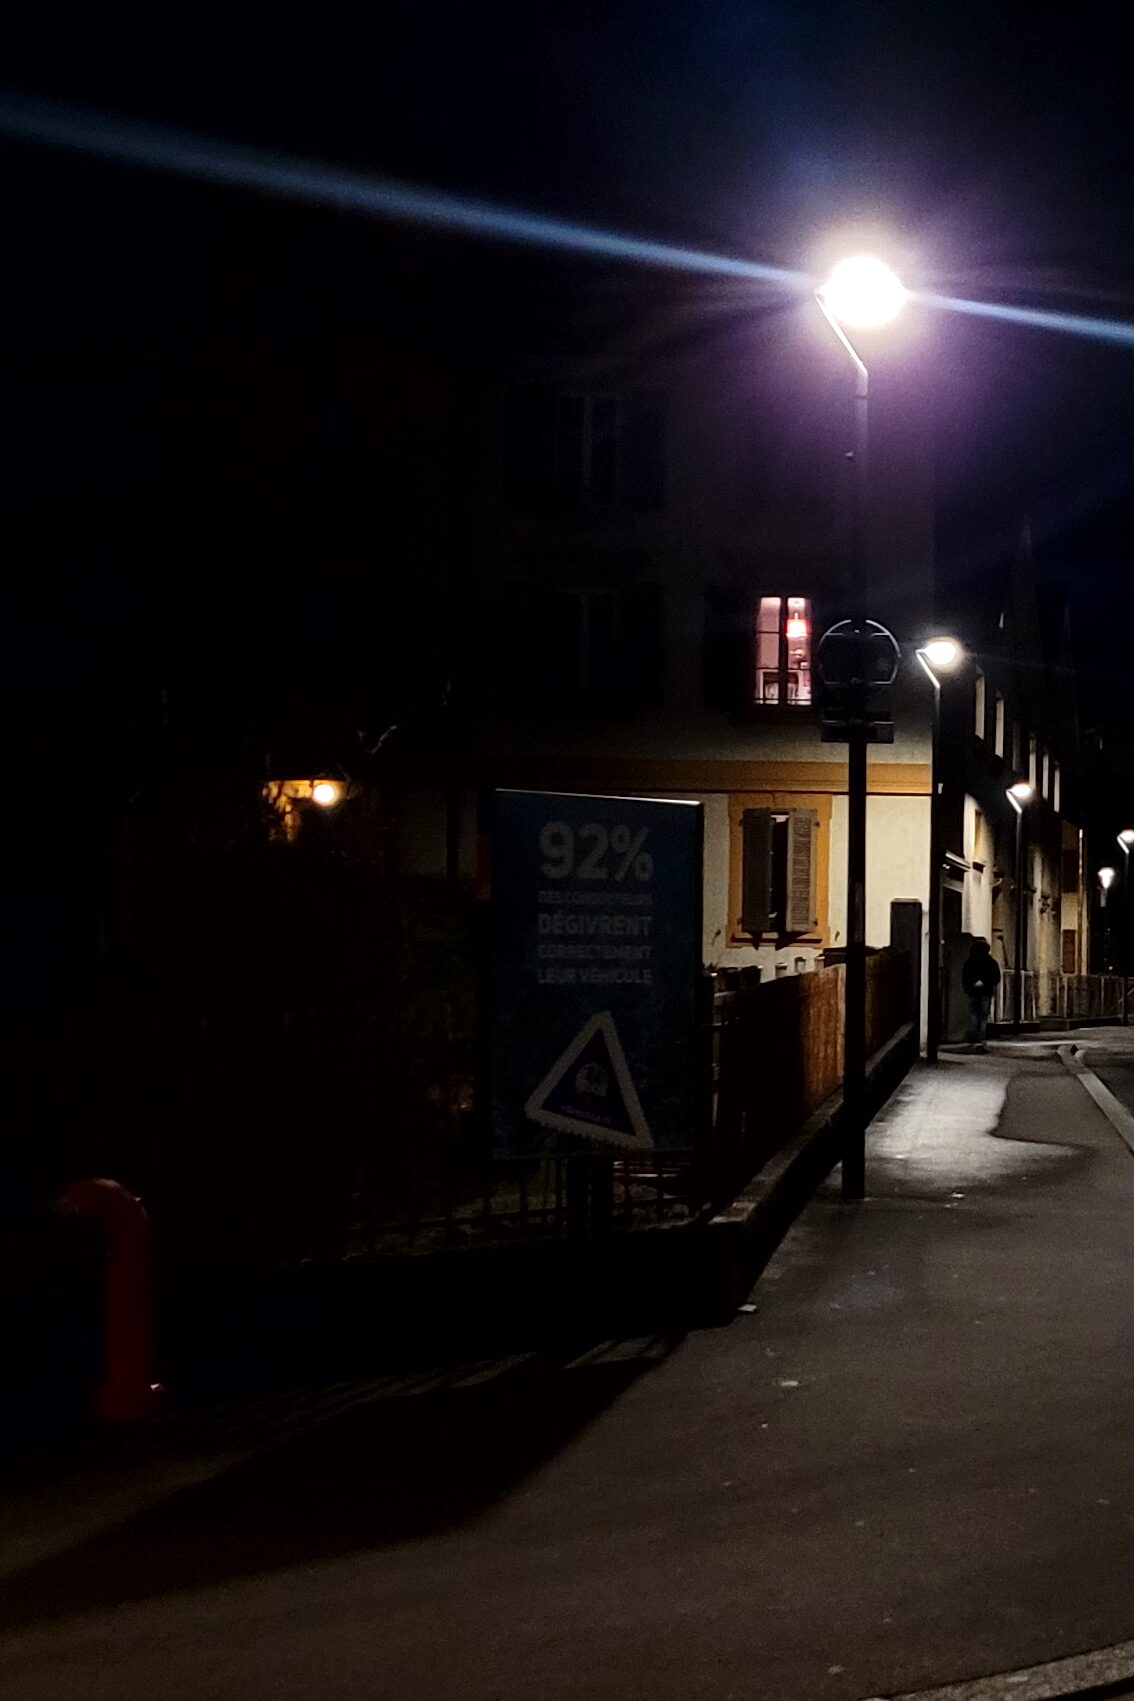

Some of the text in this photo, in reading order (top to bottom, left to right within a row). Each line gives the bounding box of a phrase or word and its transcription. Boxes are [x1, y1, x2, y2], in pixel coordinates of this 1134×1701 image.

[540, 821, 653, 881] 92%
[538, 908, 653, 936] DÉGIVRENT
[538, 967, 576, 984] LEUR
